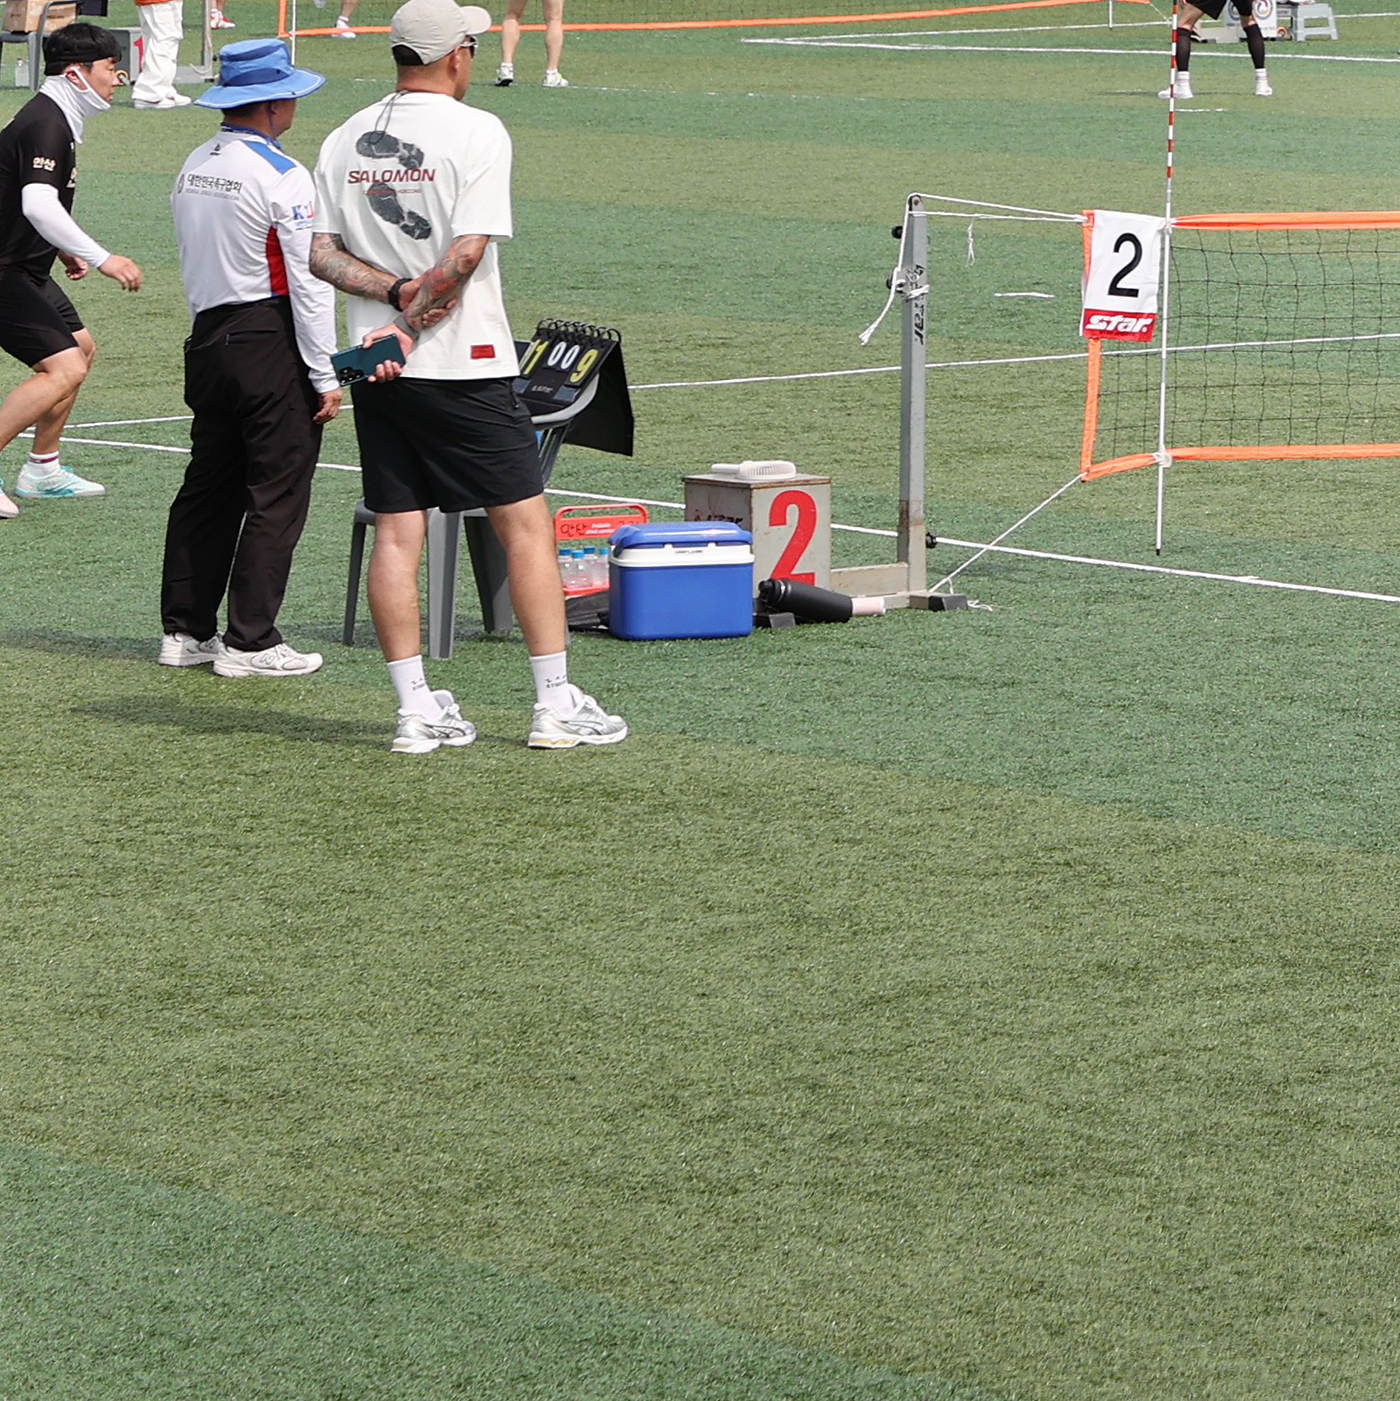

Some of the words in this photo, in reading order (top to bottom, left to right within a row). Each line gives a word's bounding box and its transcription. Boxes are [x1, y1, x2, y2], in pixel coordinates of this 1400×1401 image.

[33, 156, 56, 172] 안산
[187, 173, 243, 194] 대한민국족구협회
[348, 168, 436, 185] SALOMON
[1108, 232, 1144, 298] 2
[1086, 314, 1150, 335] star
[769, 490, 816, 585] 2
